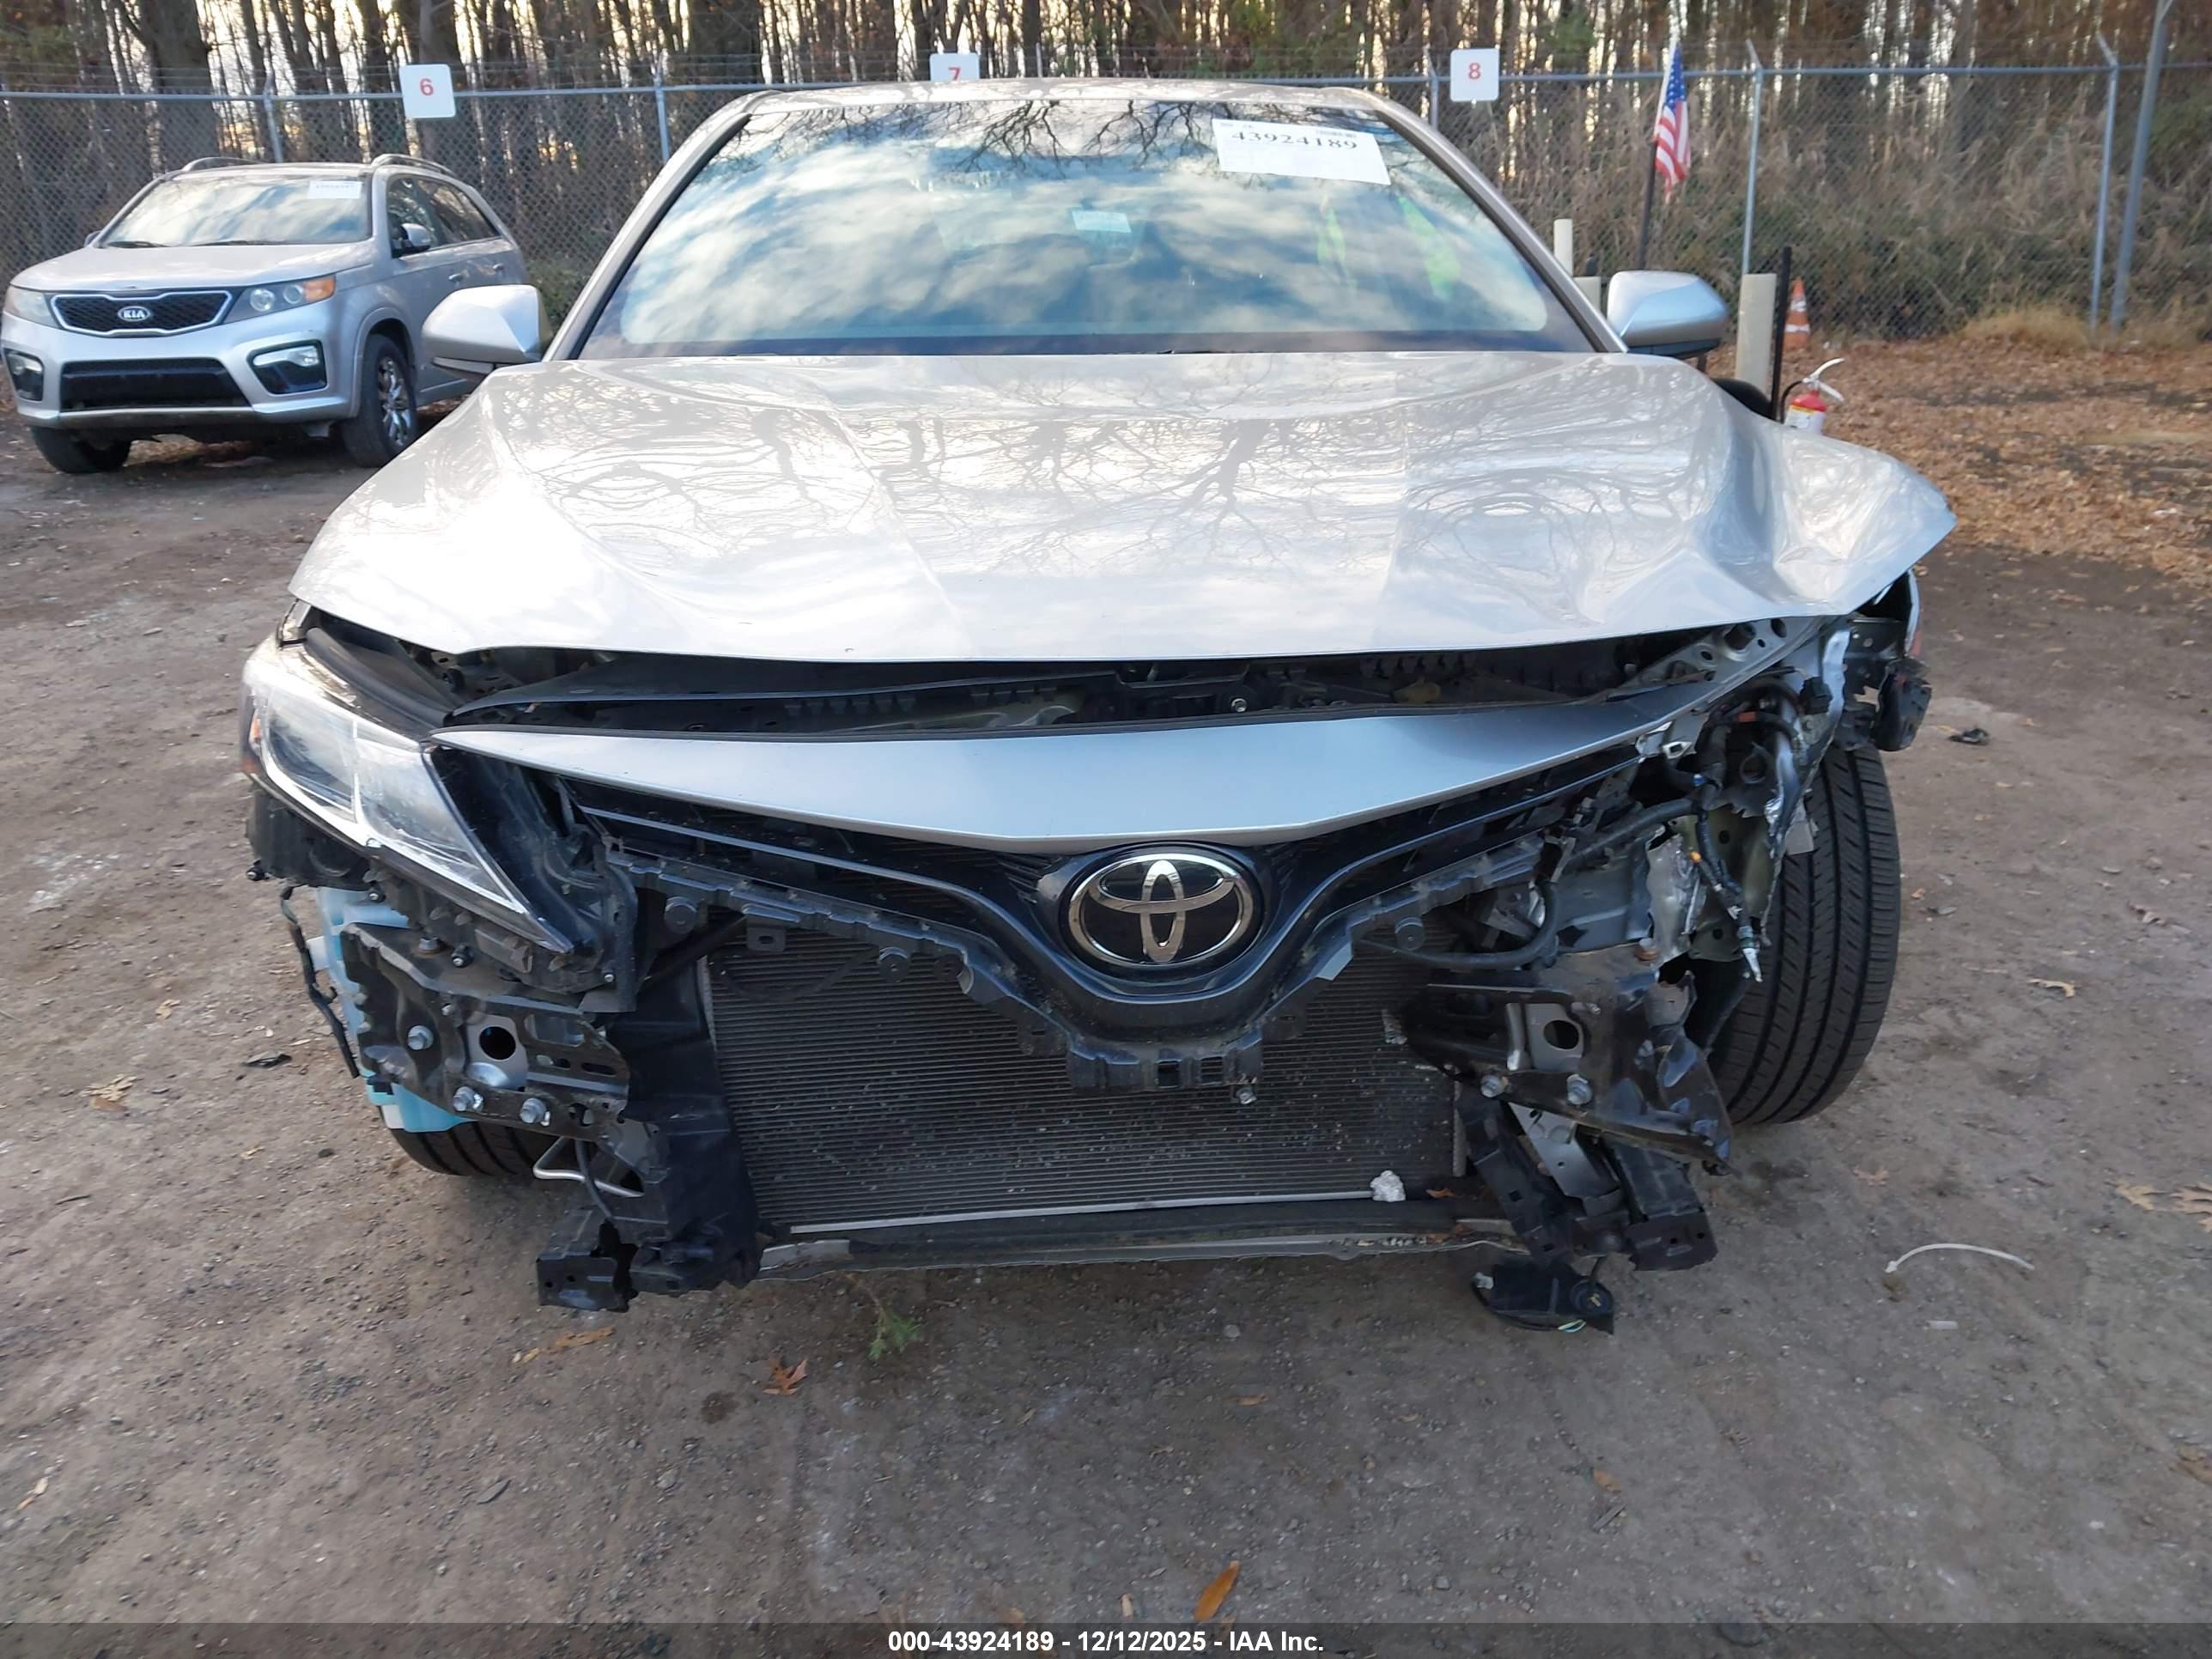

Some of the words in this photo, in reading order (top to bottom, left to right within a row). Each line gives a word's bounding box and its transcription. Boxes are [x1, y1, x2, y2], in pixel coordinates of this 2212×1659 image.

[947, 66, 962, 82] 7
[1469, 62, 1481, 80] 8
[419, 77, 434, 96] 6
[1231, 131, 1358, 149] 43924189
